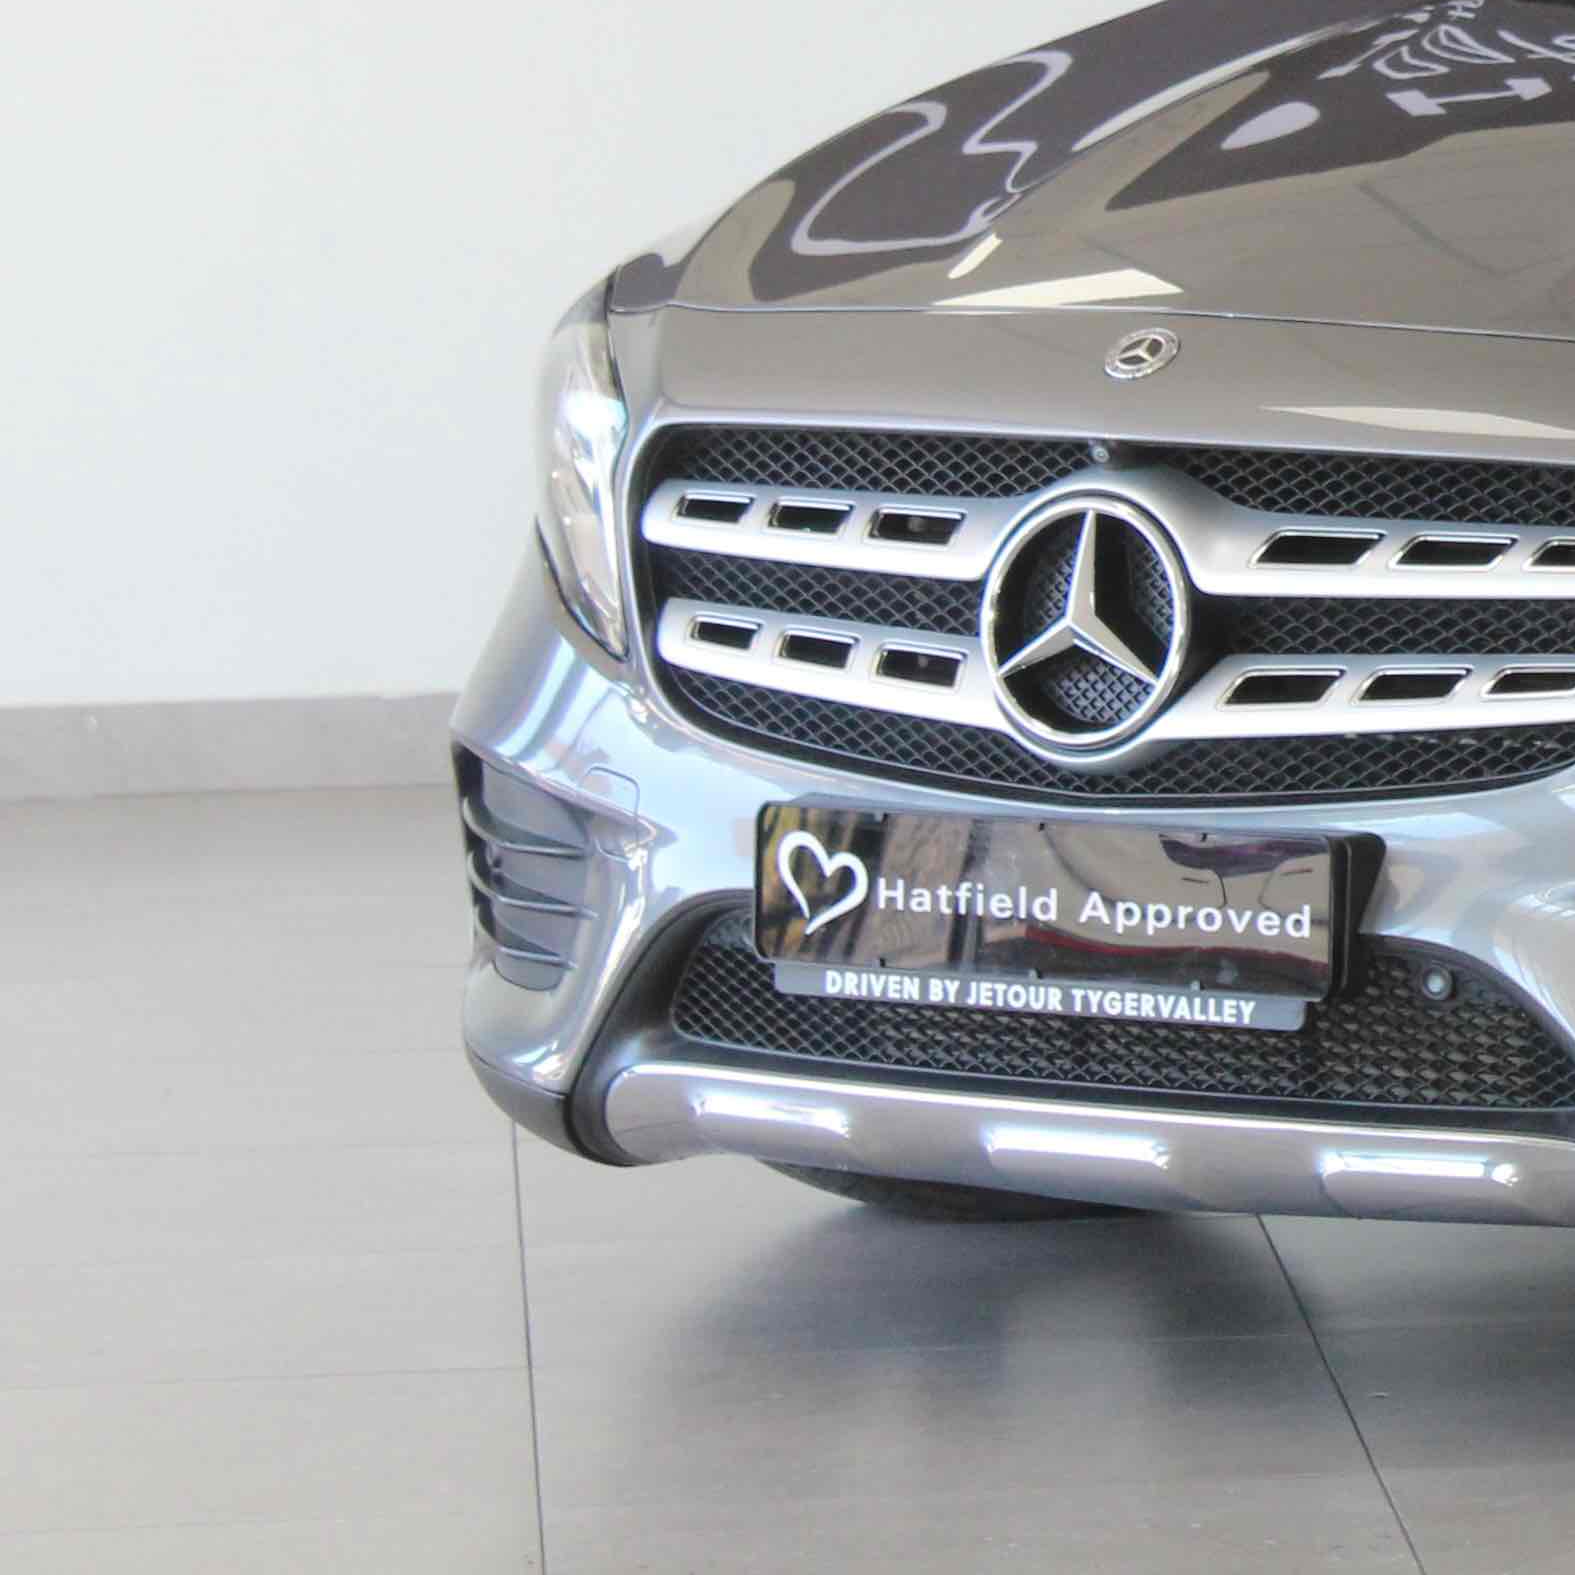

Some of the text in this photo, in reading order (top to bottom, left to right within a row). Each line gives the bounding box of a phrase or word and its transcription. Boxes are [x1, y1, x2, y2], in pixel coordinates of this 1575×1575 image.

[877, 876, 1312, 939] Hatfield Approved
[824, 969, 1257, 1026] DRIVEN BY JETOUR TYGERVALLEY
